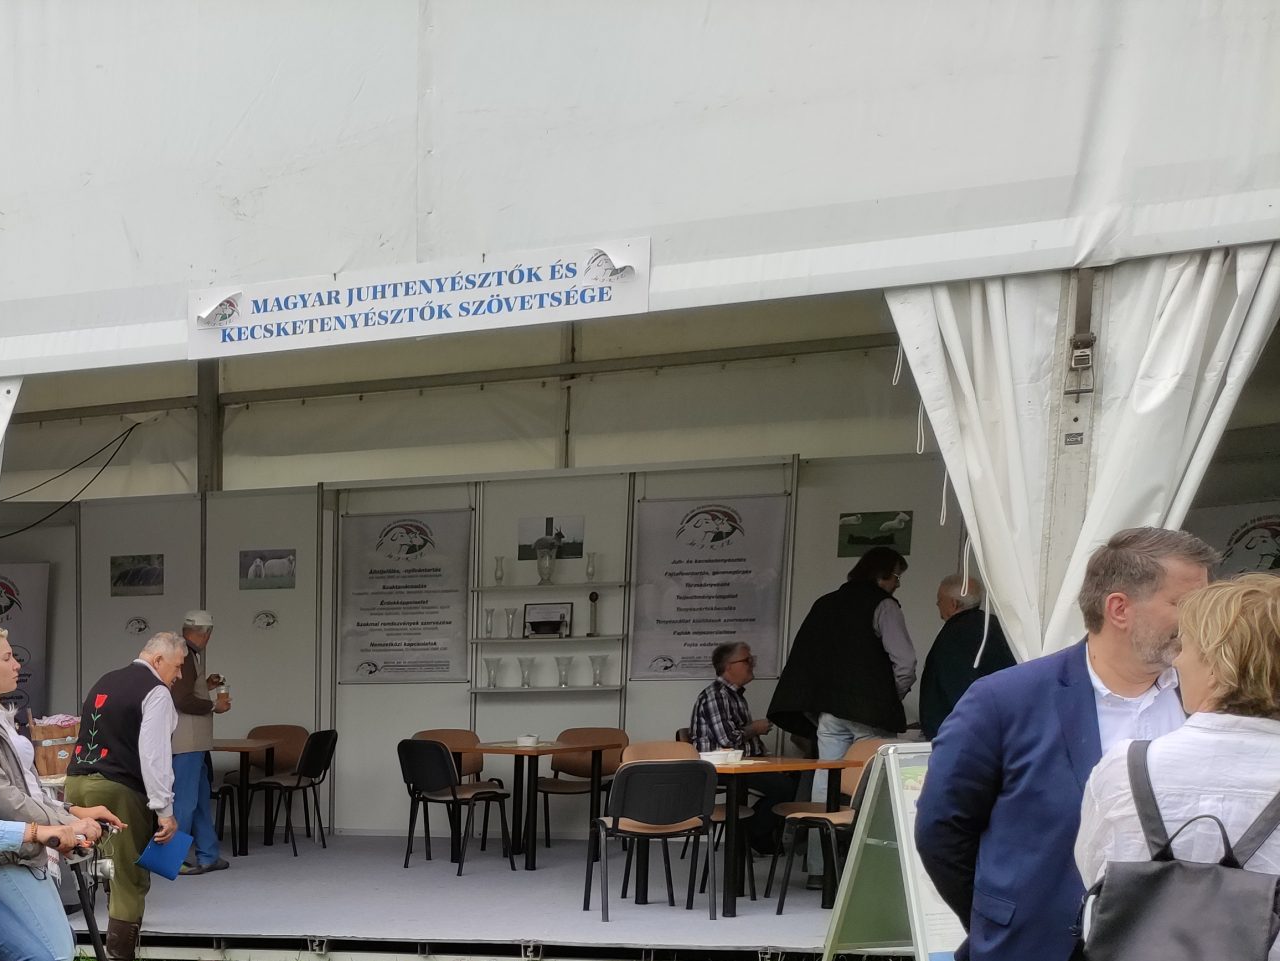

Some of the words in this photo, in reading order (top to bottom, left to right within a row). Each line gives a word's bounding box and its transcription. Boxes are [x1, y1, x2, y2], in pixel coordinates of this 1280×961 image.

[220, 299, 453, 343] KECSKETENYÉSZTŐK
[458, 285, 613, 318] SZÖVETSÉGE
[251, 289, 341, 316] MAGYAR
[347, 262, 542, 306] JUHTENYÉSZTŐK
[548, 259, 578, 281] ÉS
